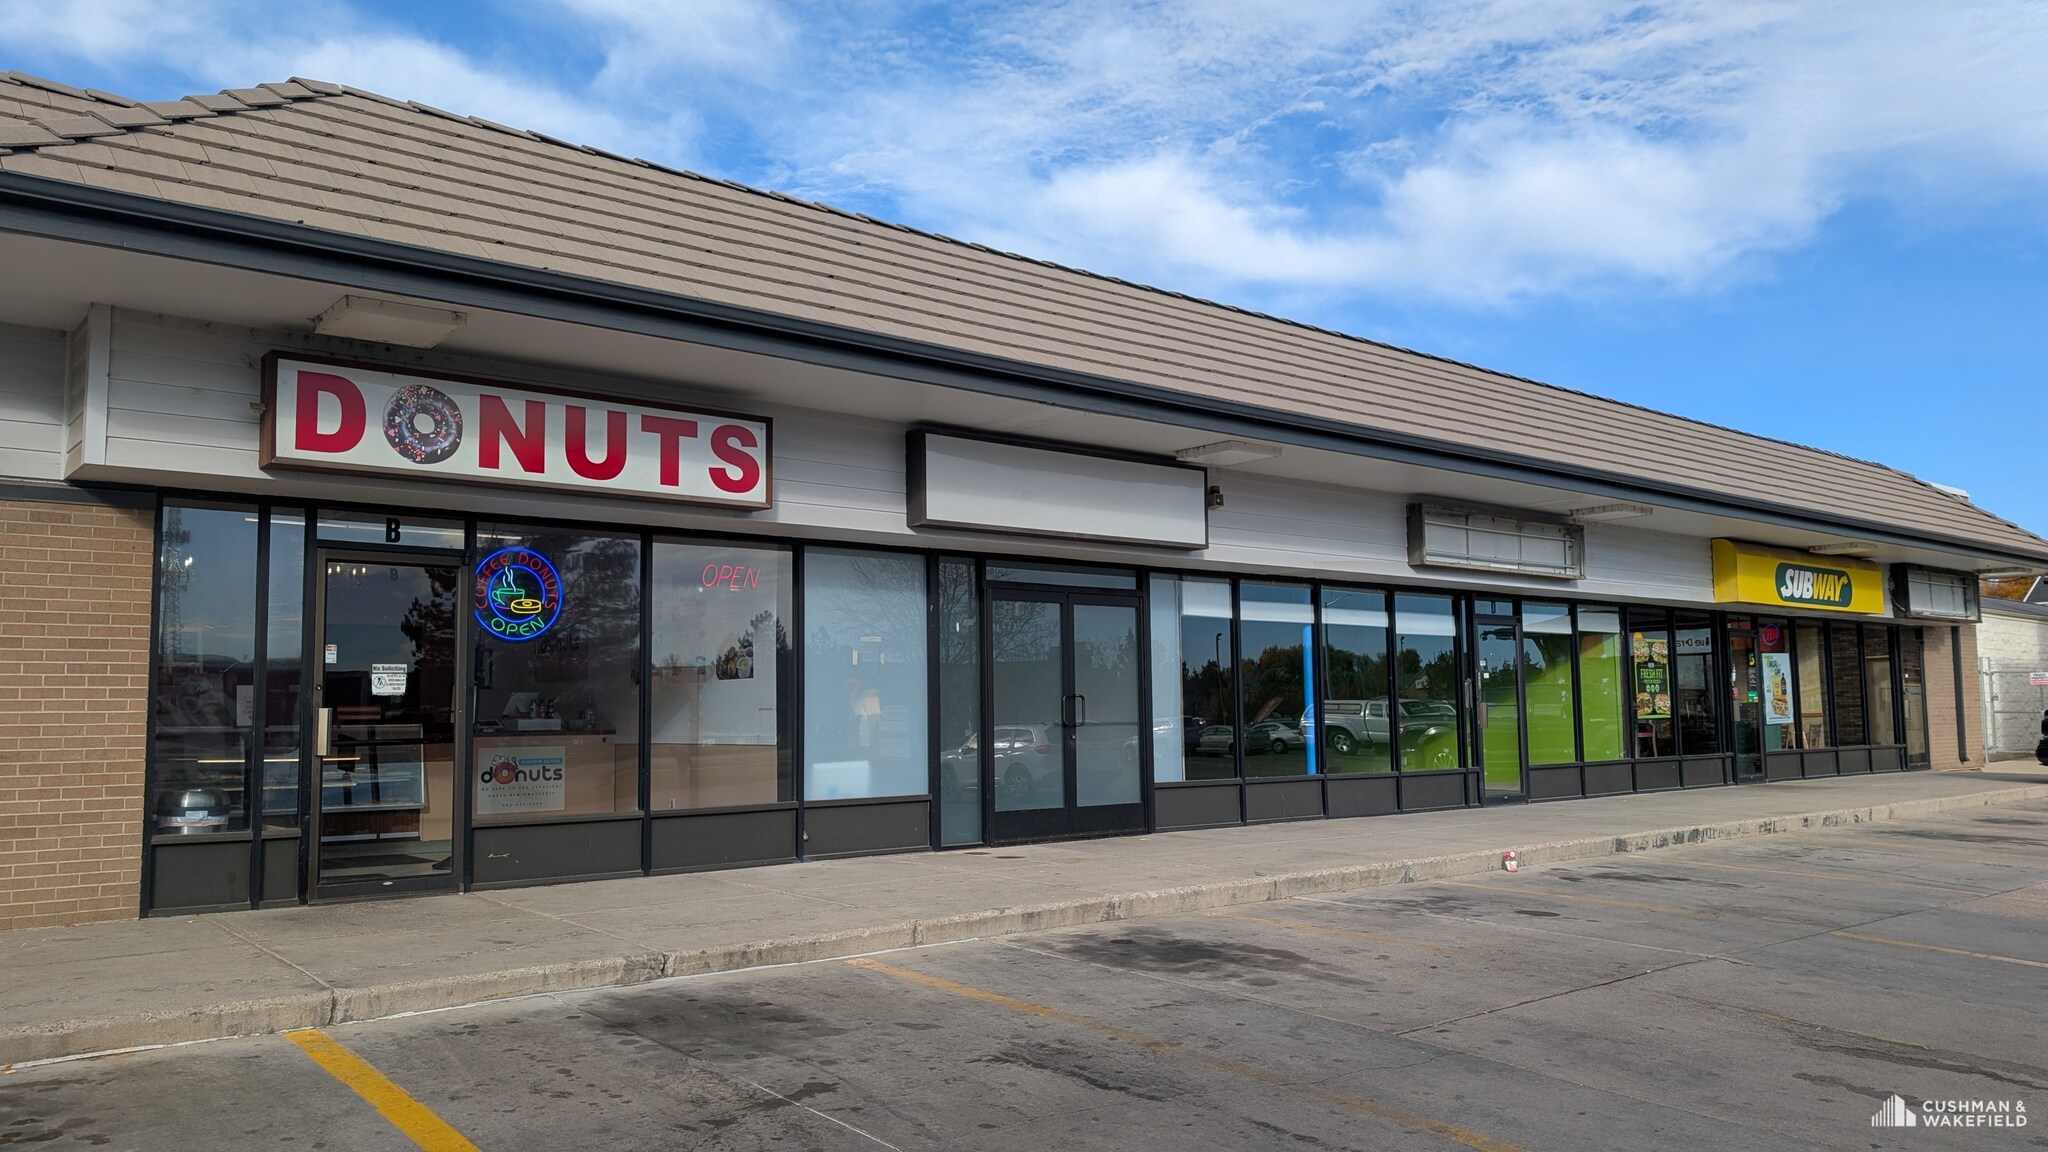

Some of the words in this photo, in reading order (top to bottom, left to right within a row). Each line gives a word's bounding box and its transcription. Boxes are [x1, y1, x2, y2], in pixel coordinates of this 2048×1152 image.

[295, 369, 761, 493] DONUTS
[386, 518, 401, 543] B
[475, 553, 509, 608] COFFEE
[518, 551, 559, 611] DONUTS
[702, 563, 760, 588] OPEN
[1780, 568, 1849, 602] SUBWAY
[491, 617, 545, 636] OPEN
[481, 765, 563, 784] donuts
